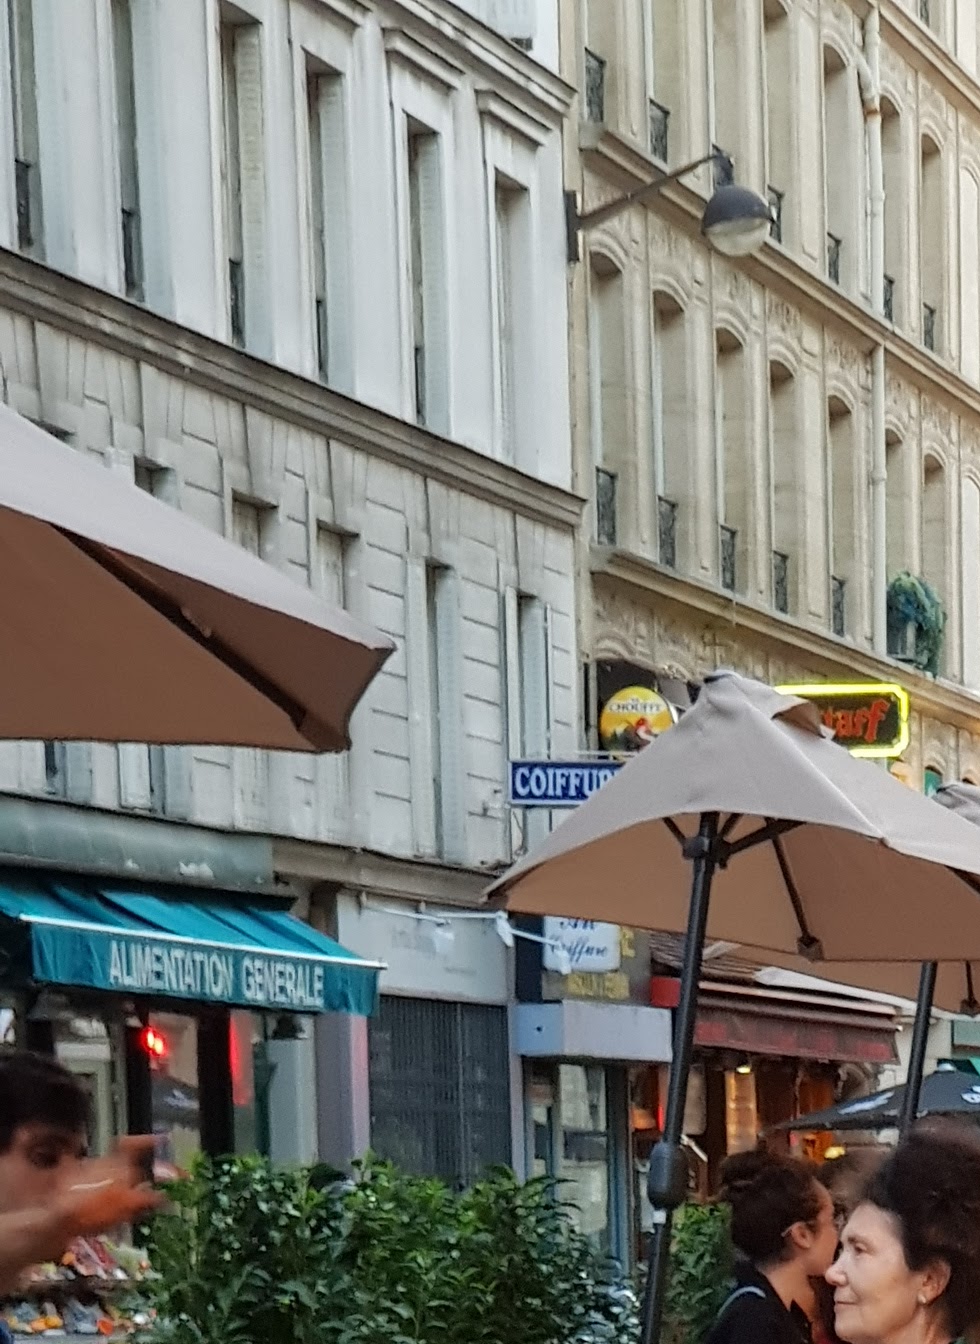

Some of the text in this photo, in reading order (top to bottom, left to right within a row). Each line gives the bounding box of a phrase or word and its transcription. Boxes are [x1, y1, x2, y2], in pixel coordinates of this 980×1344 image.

[515, 767, 620, 797] COIFFUR
[109, 940, 324, 1007] ALIMENTATION GENERALE
